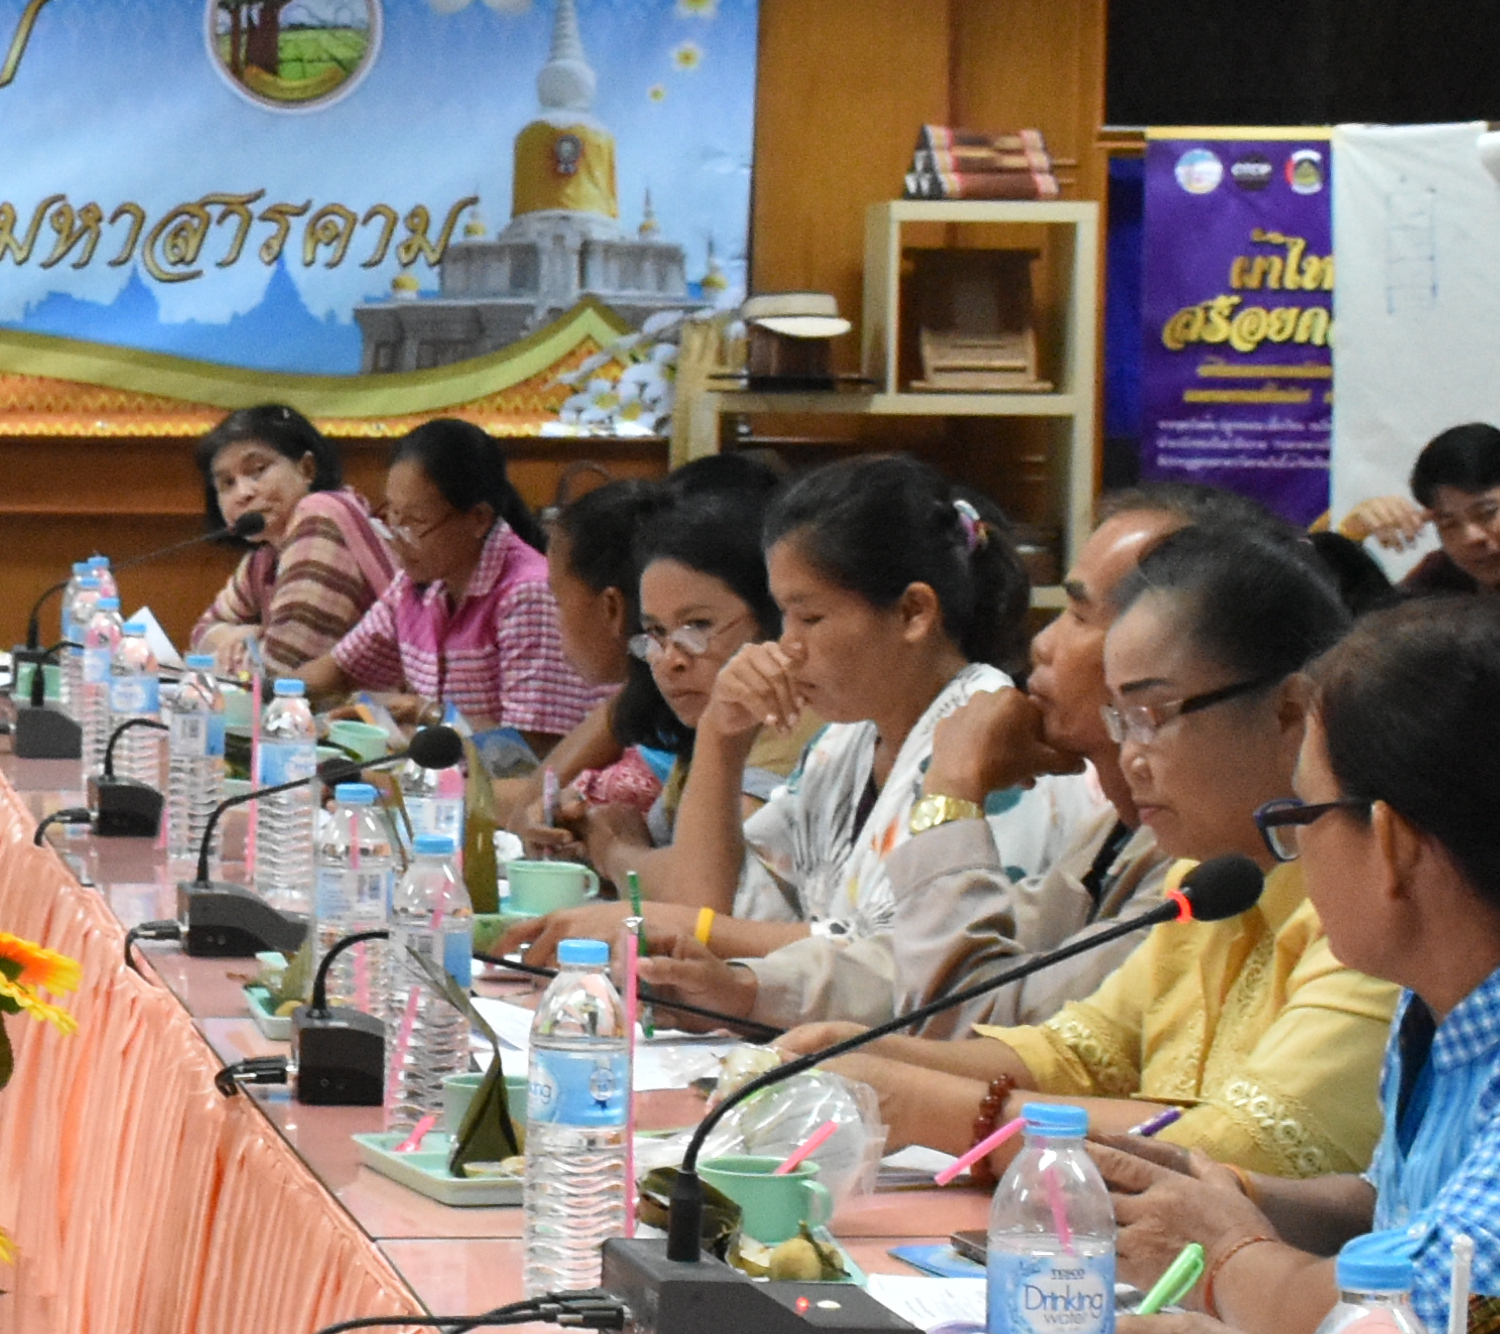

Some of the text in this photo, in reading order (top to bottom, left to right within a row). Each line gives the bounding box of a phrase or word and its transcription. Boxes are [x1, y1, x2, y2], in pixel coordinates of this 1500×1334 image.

[1161, 294, 1335, 353] สร้อยก
[1051, 1268, 1086, 1279] TESCO
[1023, 1284, 1105, 1319] Drinking
